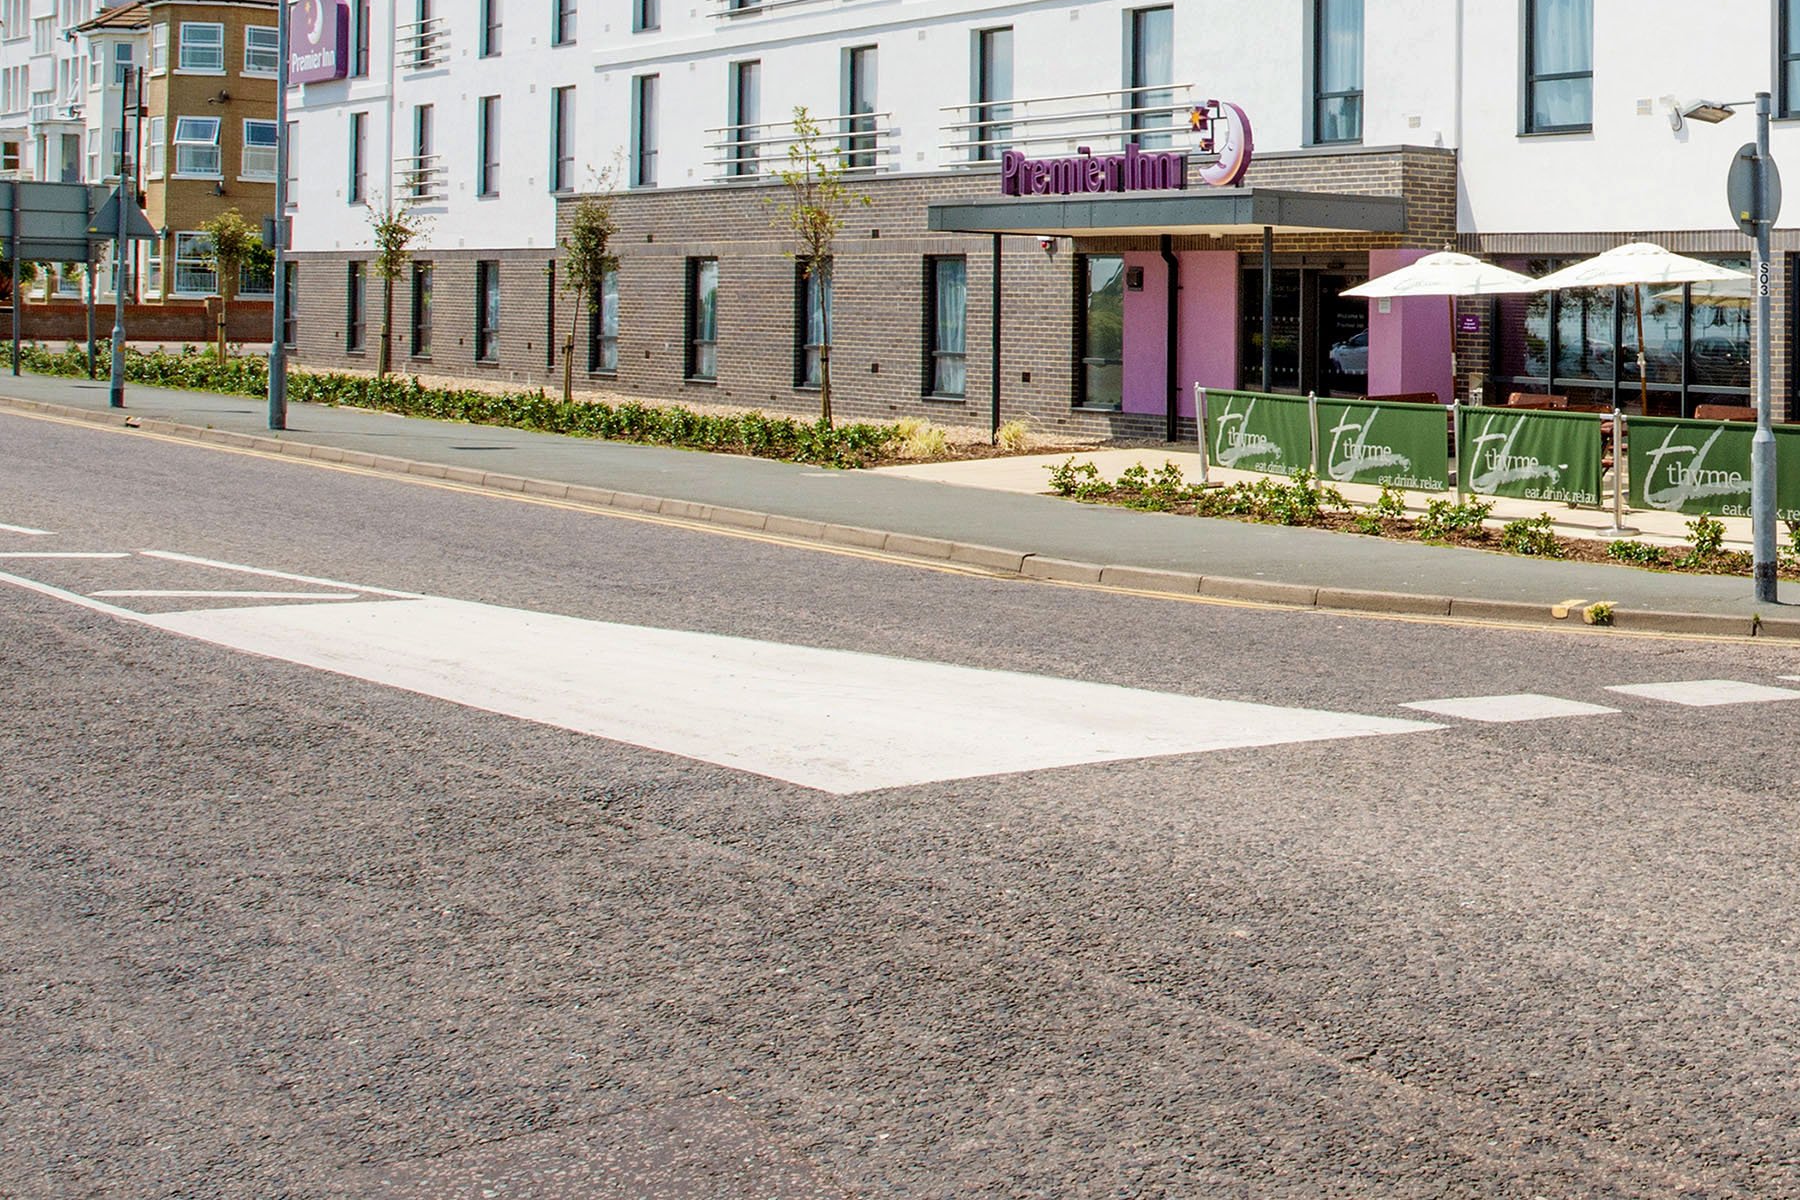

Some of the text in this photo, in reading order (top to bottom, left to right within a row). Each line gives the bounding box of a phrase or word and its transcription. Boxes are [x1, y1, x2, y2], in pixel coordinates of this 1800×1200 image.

[292, 47, 335, 73] Premier Inn
[1002, 143, 1187, 196] Premier Inn
[1484, 448, 1539, 475] thyme
[1666, 461, 1742, 492] thyme
